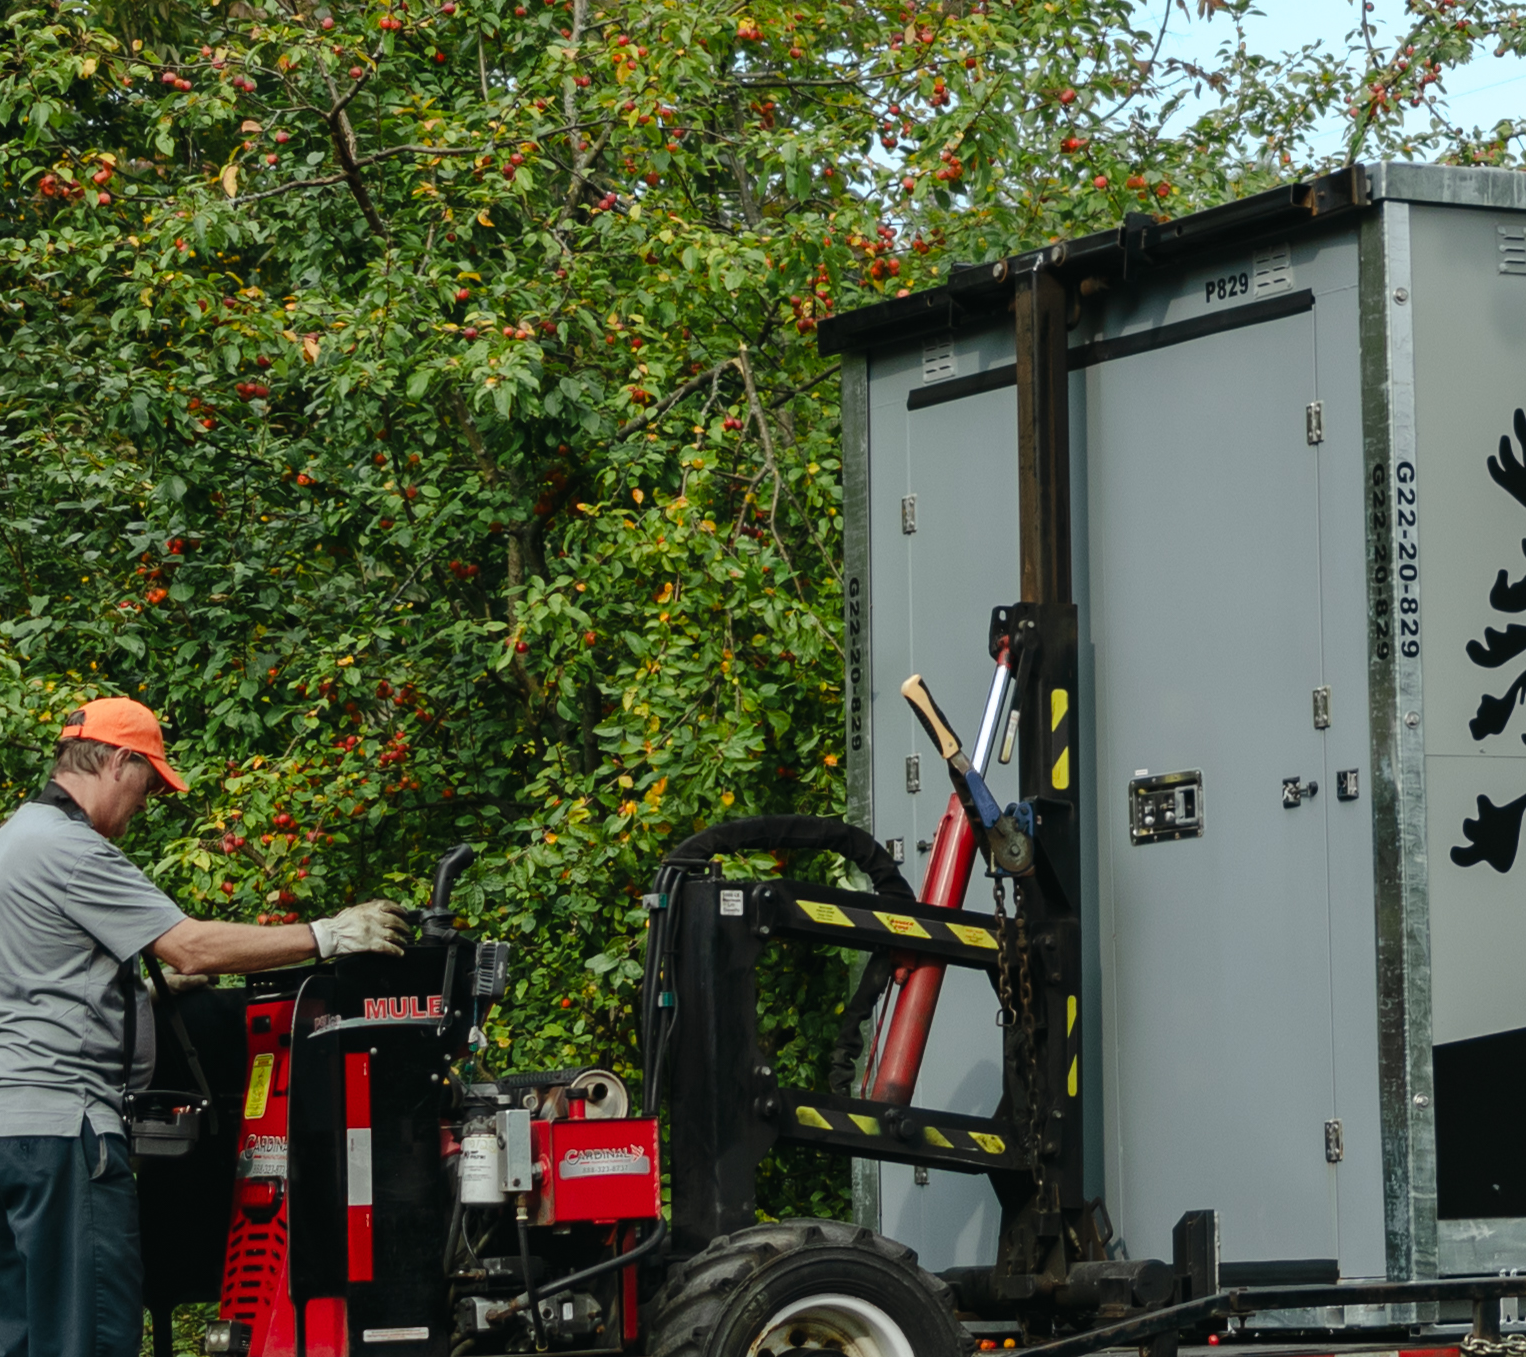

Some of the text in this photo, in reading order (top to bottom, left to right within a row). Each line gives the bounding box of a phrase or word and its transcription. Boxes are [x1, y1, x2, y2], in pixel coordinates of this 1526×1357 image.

[1205, 272, 1249, 303] P829
[1371, 462, 1391, 662] G22-20-829
[1396, 460, 1420, 660] G22-20-829
[848, 576, 862, 752] G22-20-829
[364, 995, 444, 1021] MULE
[565, 1146, 630, 1165] CARDINAL
